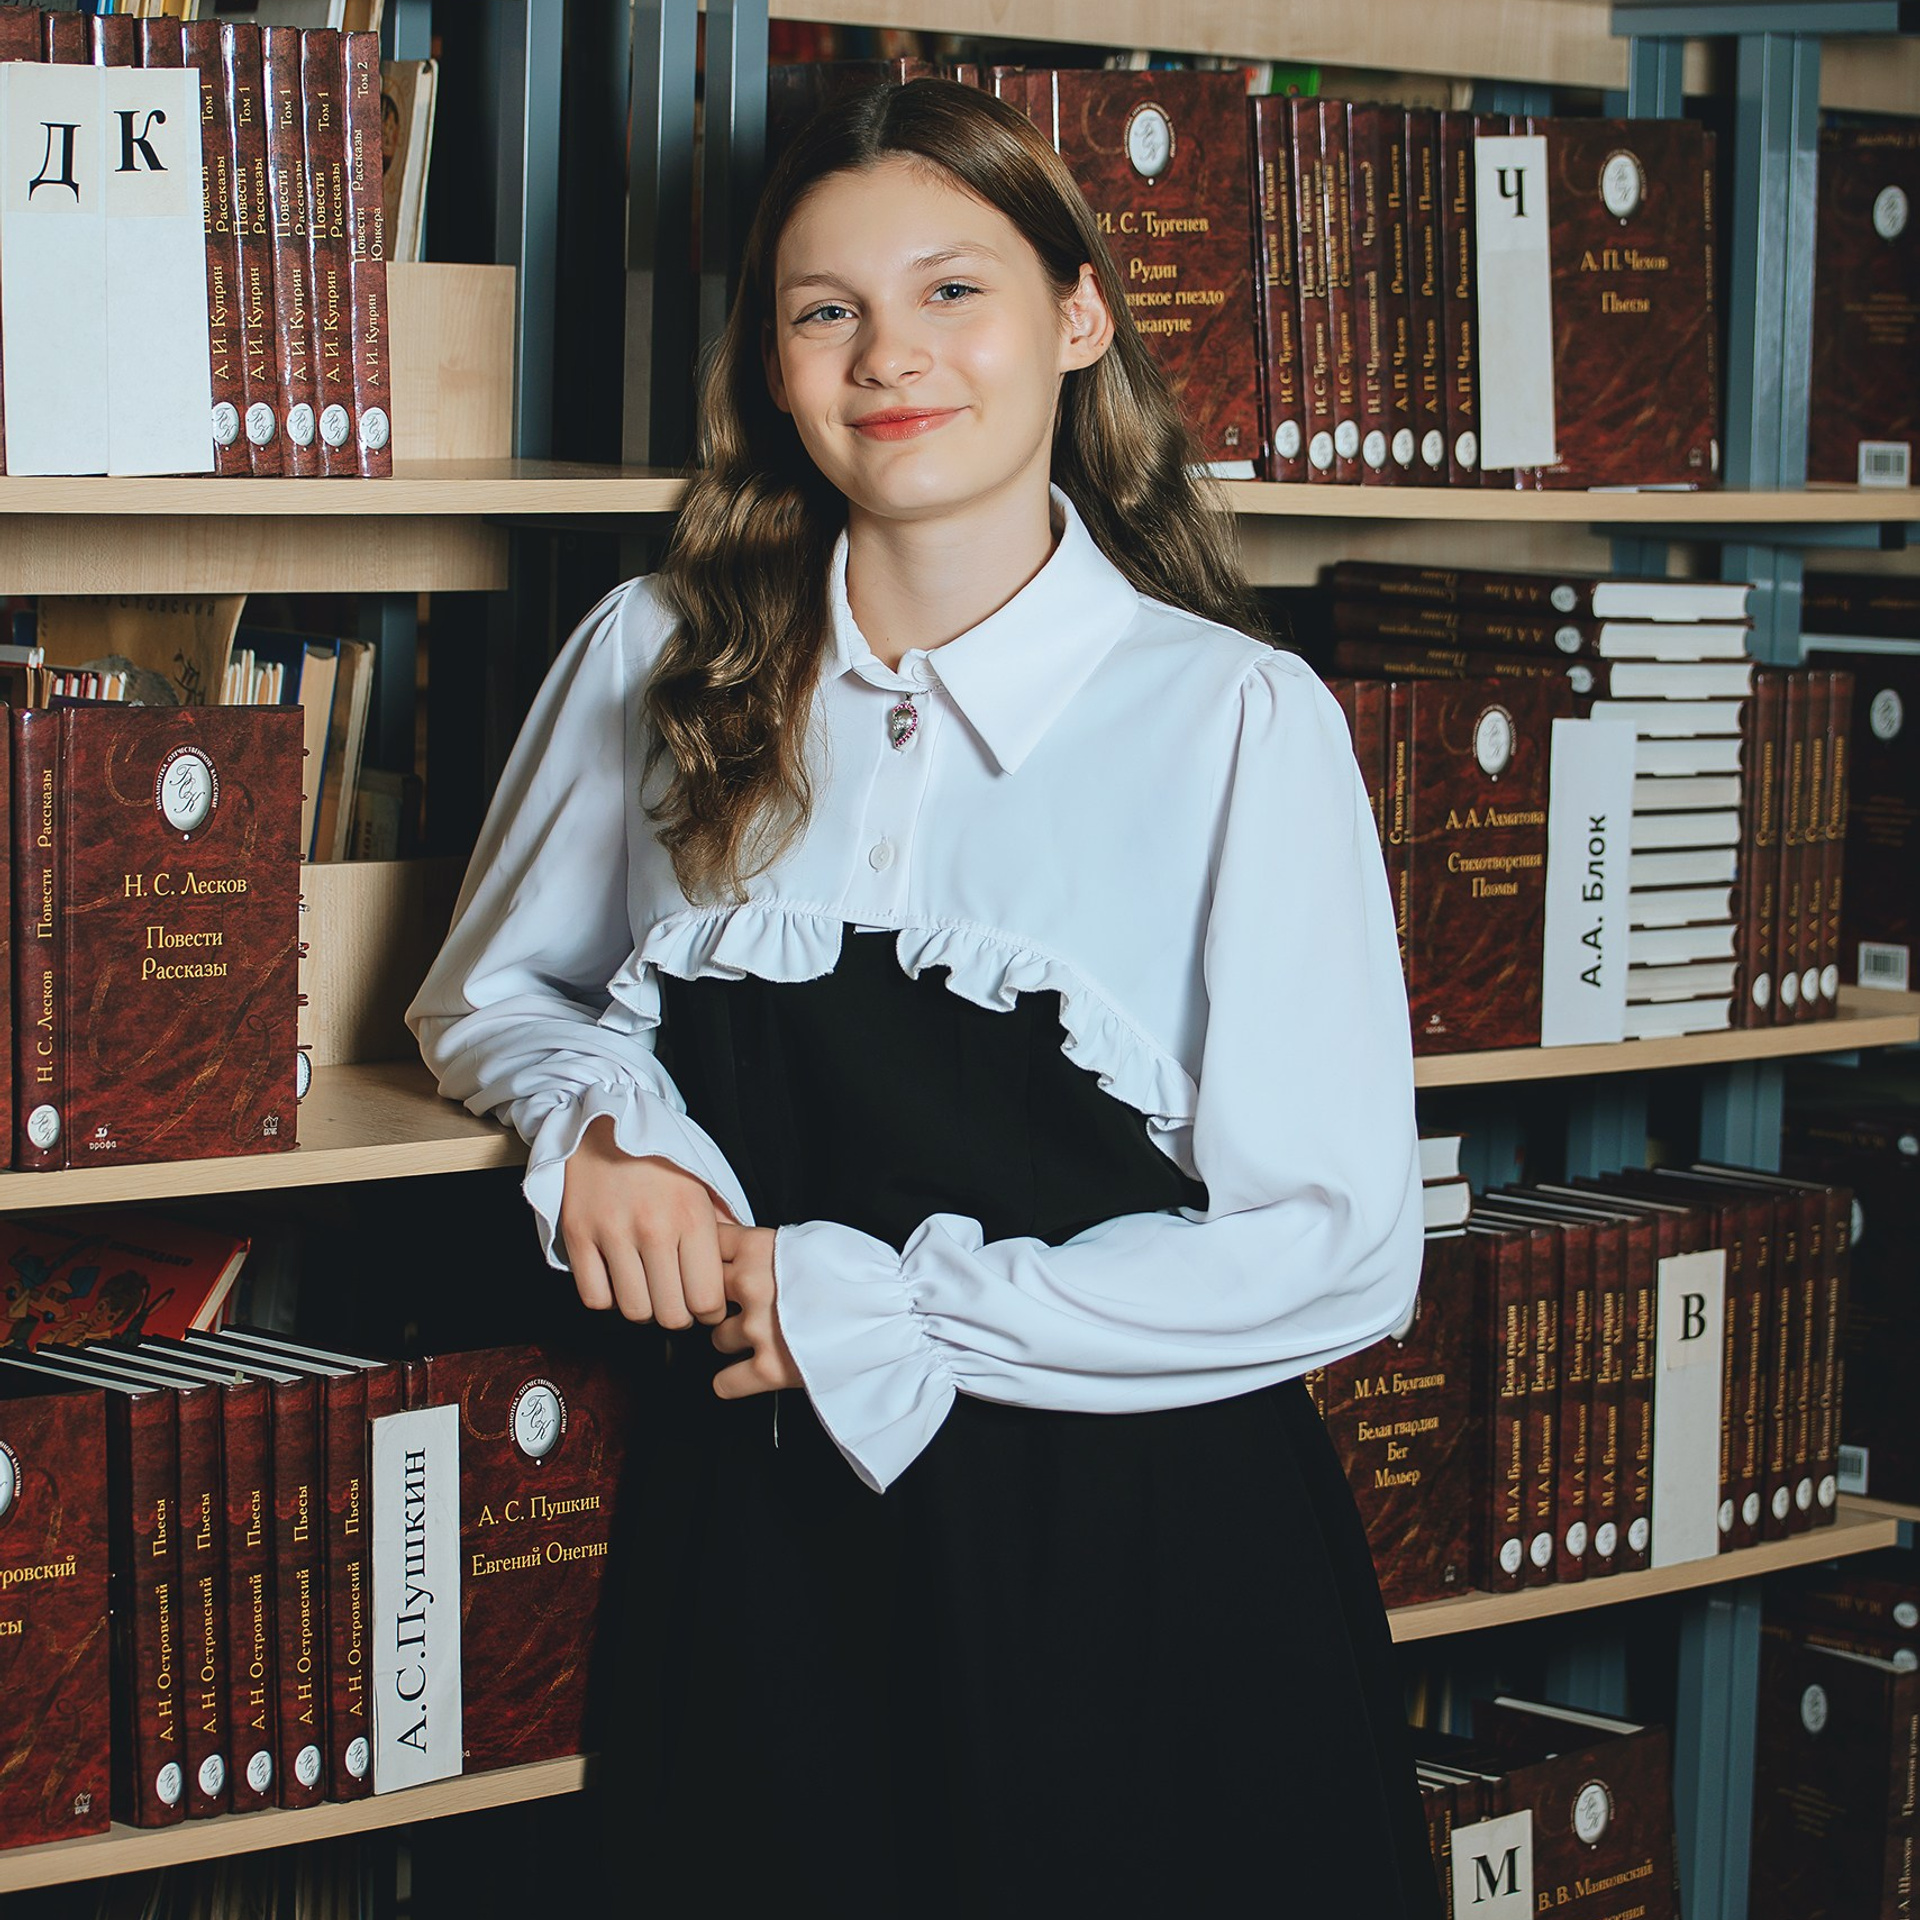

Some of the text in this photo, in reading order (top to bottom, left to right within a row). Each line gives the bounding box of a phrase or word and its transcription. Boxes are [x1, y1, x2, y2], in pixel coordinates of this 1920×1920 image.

[358, 61, 369, 98] Том 2
[202, 95, 214, 125] Том
[240, 97, 252, 126] Том
[281, 101, 292, 129] Том
[318, 103, 330, 132] Том
[29, 122, 81, 203] Д
[113, 109, 168, 172] К
[351, 129, 364, 191] Рассказы
[216, 155, 229, 232] Рассказы
[234, 167, 249, 236] Повести
[252, 158, 266, 234] Рассказы
[277, 169, 291, 238] Повести
[294, 160, 306, 236] Рассказы
[312, 172, 326, 240] Повести
[329, 162, 342, 238] Рассказы
[1497, 167, 1528, 218] Ч
[353, 207, 367, 263] Повести
[371, 207, 384, 262] Юнкера
[1120, 212, 1139, 233] С.
[1142, 211, 1209, 237] Тургенев
[1130, 258, 1177, 283] Рудин
[1580, 249, 1668, 271] А. П. Чехов
[211, 265, 229, 380] А. И. Куприн
[248, 267, 265, 380] А. И. Куприн
[290, 269, 307, 381] А. И. Куприн
[323, 270, 341, 382] А. И. Куприн
[1175, 290, 1225, 306] гнездо
[1602, 292, 1649, 313] Пьесы
[365, 294, 380, 385] А. И. Куприн
[1131, 318, 1192, 336] акануне
[37, 769, 52, 848] Рассказы
[1446, 807, 1545, 829] А. А. Ахматова
[125, 872, 247, 897] Н. С. Лесков
[1447, 853, 1543, 873] Стихотворения
[1472, 879, 1518, 898] Поэмы
[37, 869, 52, 938] Повести
[1580, 815, 1605, 987] А.А. Блок
[146, 926, 223, 949] Повести
[142, 957, 227, 981] Рассказы
[36, 970, 53, 1082] Н. С. Лесков
[1679, 1292, 1706, 1342] В
[1354, 1373, 1445, 1399] М. А. Булгаков
[1359, 1417, 1439, 1440] Белая гвардия
[1387, 1442, 1409, 1461] Бег
[345, 1478, 359, 1535] Пьесы
[1375, 1469, 1421, 1488] Мольер
[153, 1498, 166, 1556] Пьесы
[197, 1492, 211, 1550] Пьесы
[247, 1490, 261, 1546] Пьесы
[294, 1485, 308, 1542] Пьесы
[478, 1496, 600, 1527] А. С. Пушкин
[0, 1555, 76, 1589] ровский
[472, 1542, 608, 1576] Евгений Онегин
[396, 1448, 434, 1753] А.С.Пушкин
[155, 1583, 173, 1741] А. Н. Островский
[199, 1577, 216, 1733] А. Н. Островский
[249, 1573, 265, 1729] А. Н. Островский
[296, 1568, 313, 1724] А. Н. Островский
[347, 1561, 362, 1716] А. Н. Островский
[1471, 1846, 1522, 1904] М
